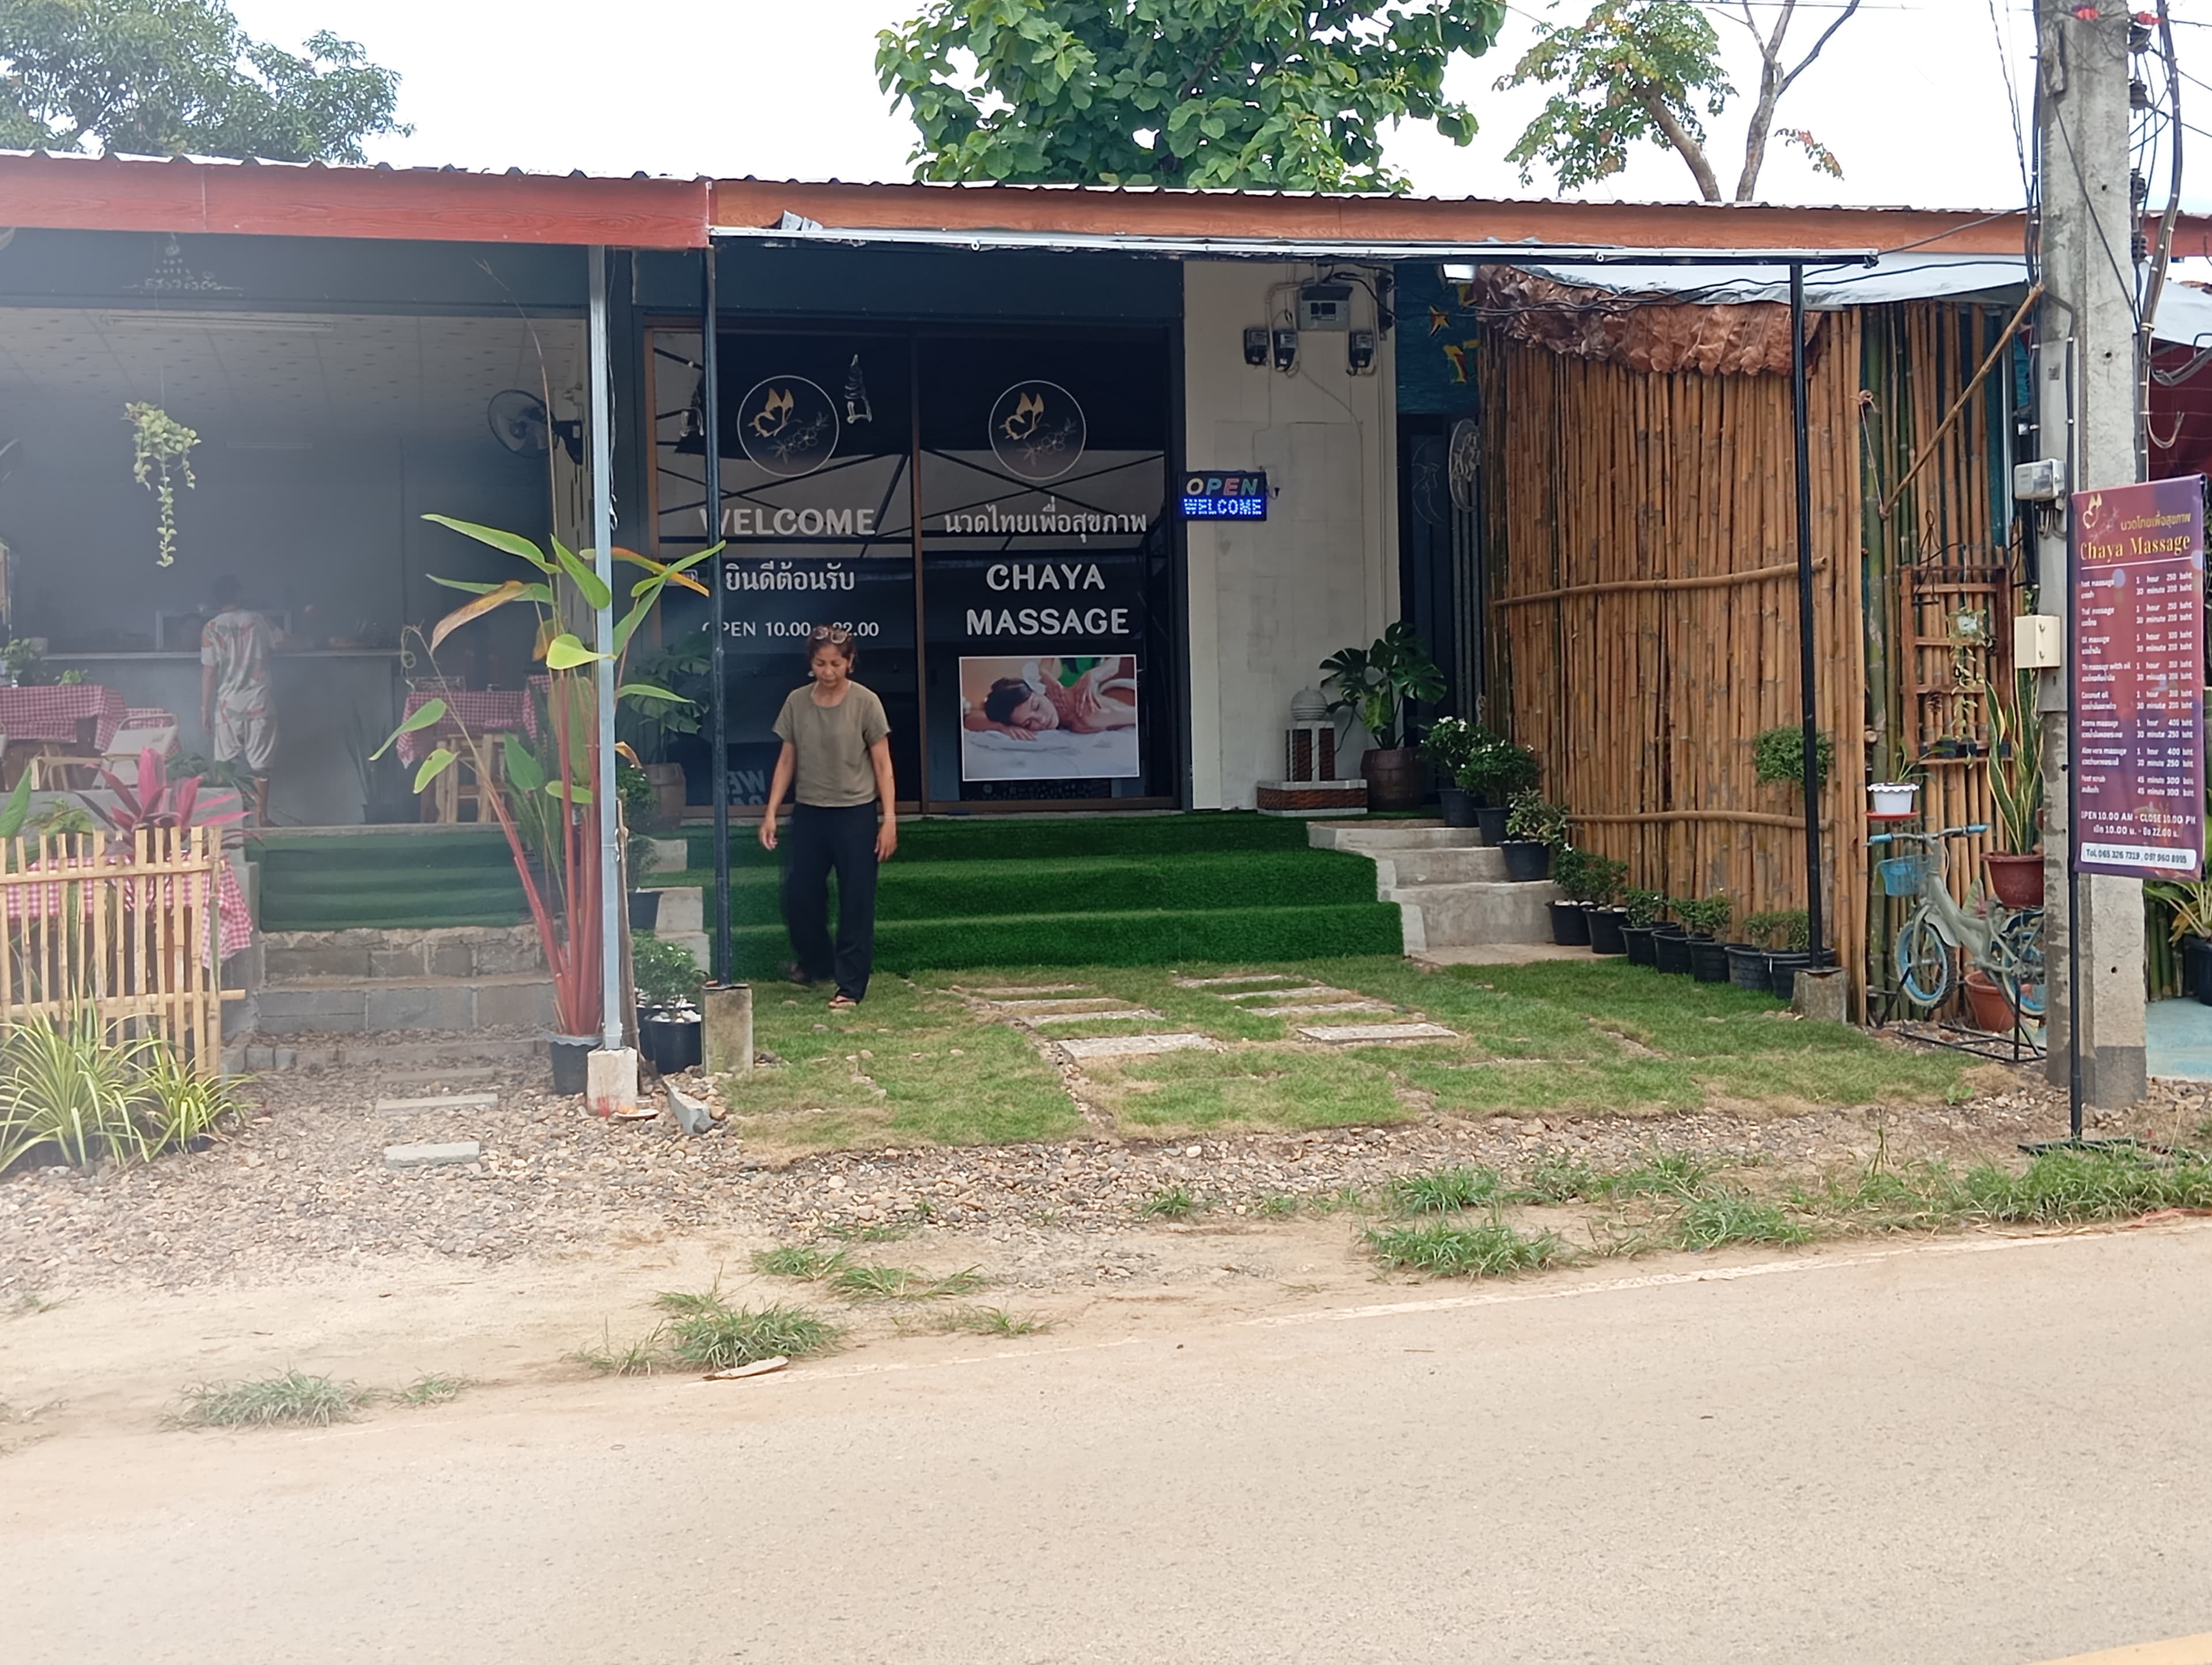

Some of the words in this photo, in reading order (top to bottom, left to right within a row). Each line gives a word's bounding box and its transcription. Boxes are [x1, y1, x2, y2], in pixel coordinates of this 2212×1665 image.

[1186, 477, 1258, 495] OPEN
[1184, 499, 1262, 515] WELCOME
[945, 496, 1147, 543] นวดไทยเพื่อสุขภาพ
[2080, 541, 2123, 563] Chaya
[2130, 535, 2190, 556] Massage
[725, 560, 855, 590] ยินดีต้อนรับ
[986, 563, 1105, 590] CHAYA
[2137, 576, 2139, 584] 1
[702, 621, 756, 636] EN
[765, 622, 811, 636] 10.00
[967, 608, 1129, 635] MASSAGE
[2137, 634, 2140, 642] 1
[2168, 730, 2179, 738] 250
[2166, 759, 2180, 767] 250
[2081, 811, 2097, 820] OPEN
[2098, 811, 2119, 821] 10.00
[2121, 812, 2133, 821] AM
[2140, 813, 2161, 823] CLOSE
[2163, 814, 2183, 824] 10.00
[2186, 816, 2196, 824] PM
[2105, 825, 2127, 835] 10.00
[2152, 828, 2172, 837] 22.00
[2098, 849, 2110, 858] 065
